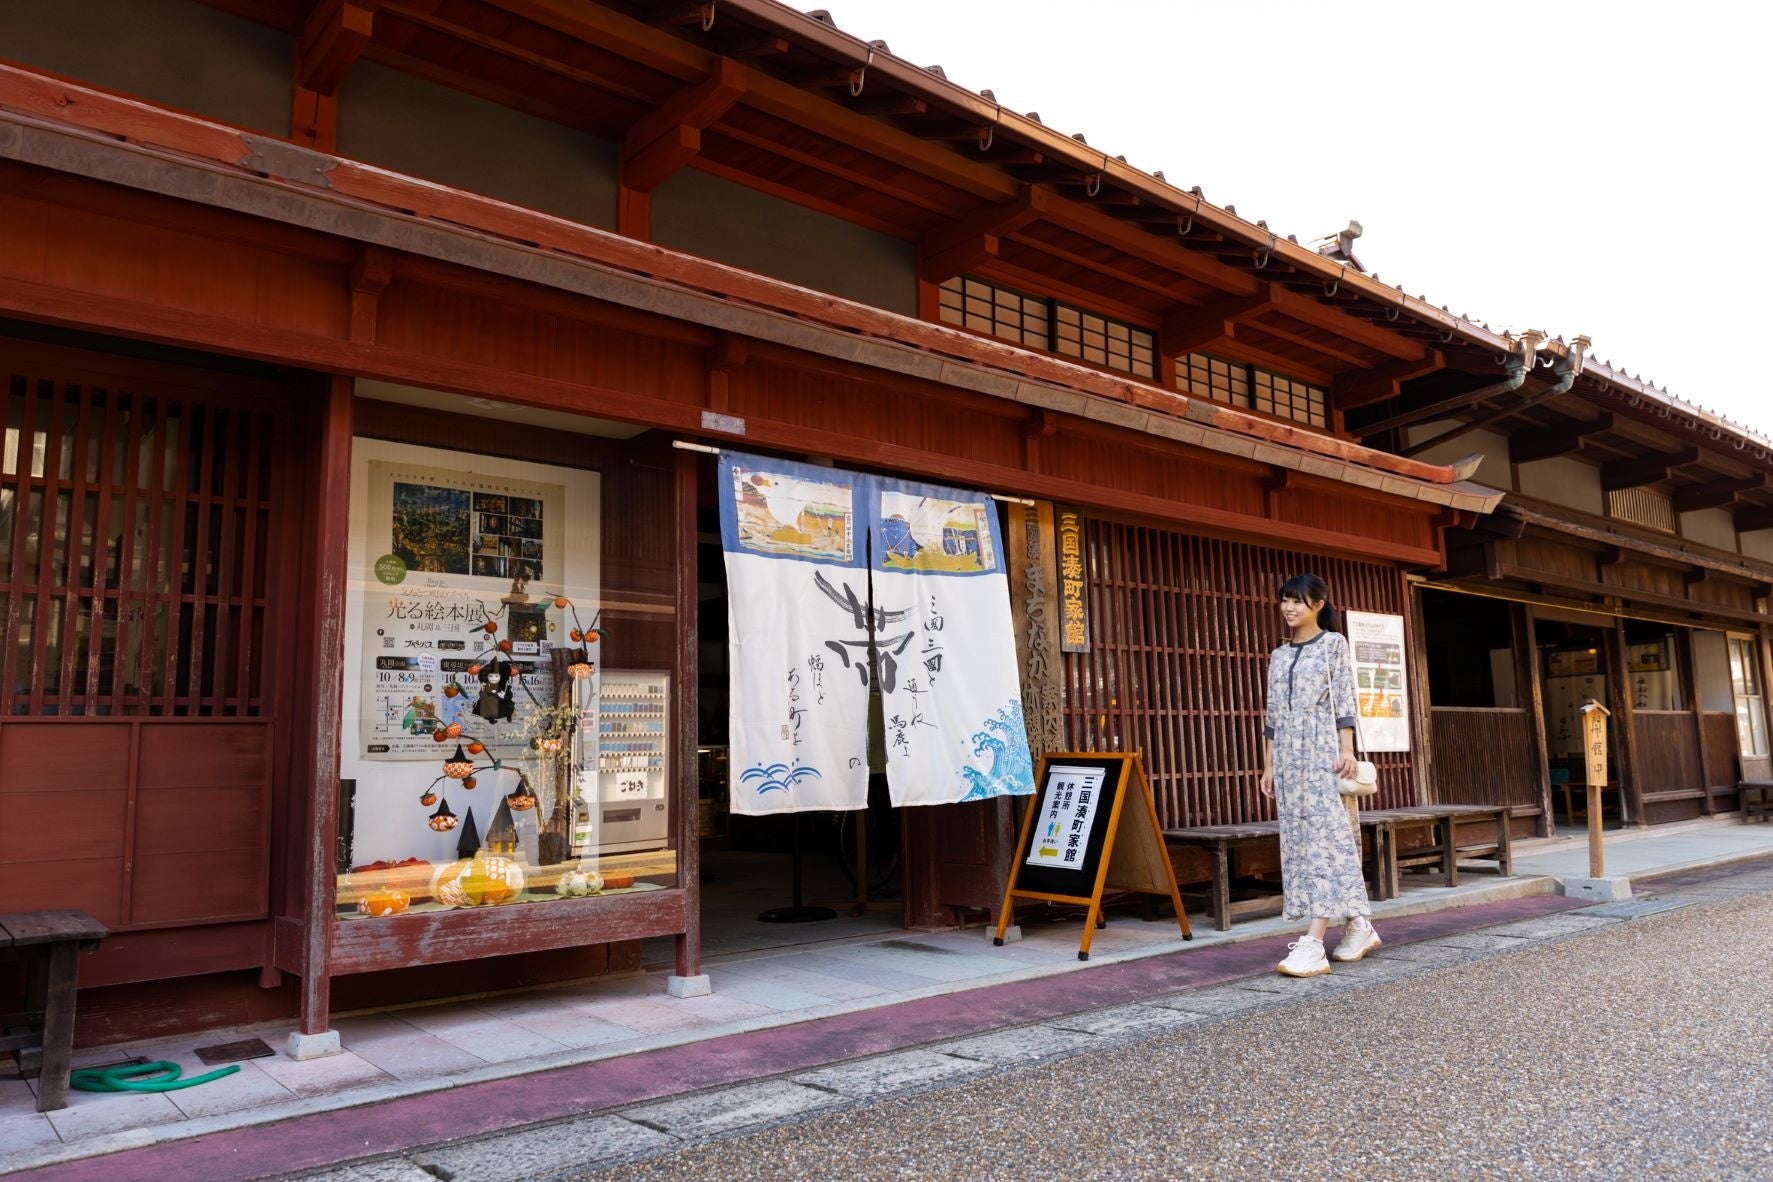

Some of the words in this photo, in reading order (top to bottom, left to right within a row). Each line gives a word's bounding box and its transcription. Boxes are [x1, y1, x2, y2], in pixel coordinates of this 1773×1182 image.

[1061, 512, 1085, 646] 三国湊町家館
[385, 598, 484, 623] 光る絵本展
[1049, 781, 1065, 819] 観光案内
[1061, 782, 1075, 810] 休憩所
[1063, 776, 1095, 863] 三国湊町家館
